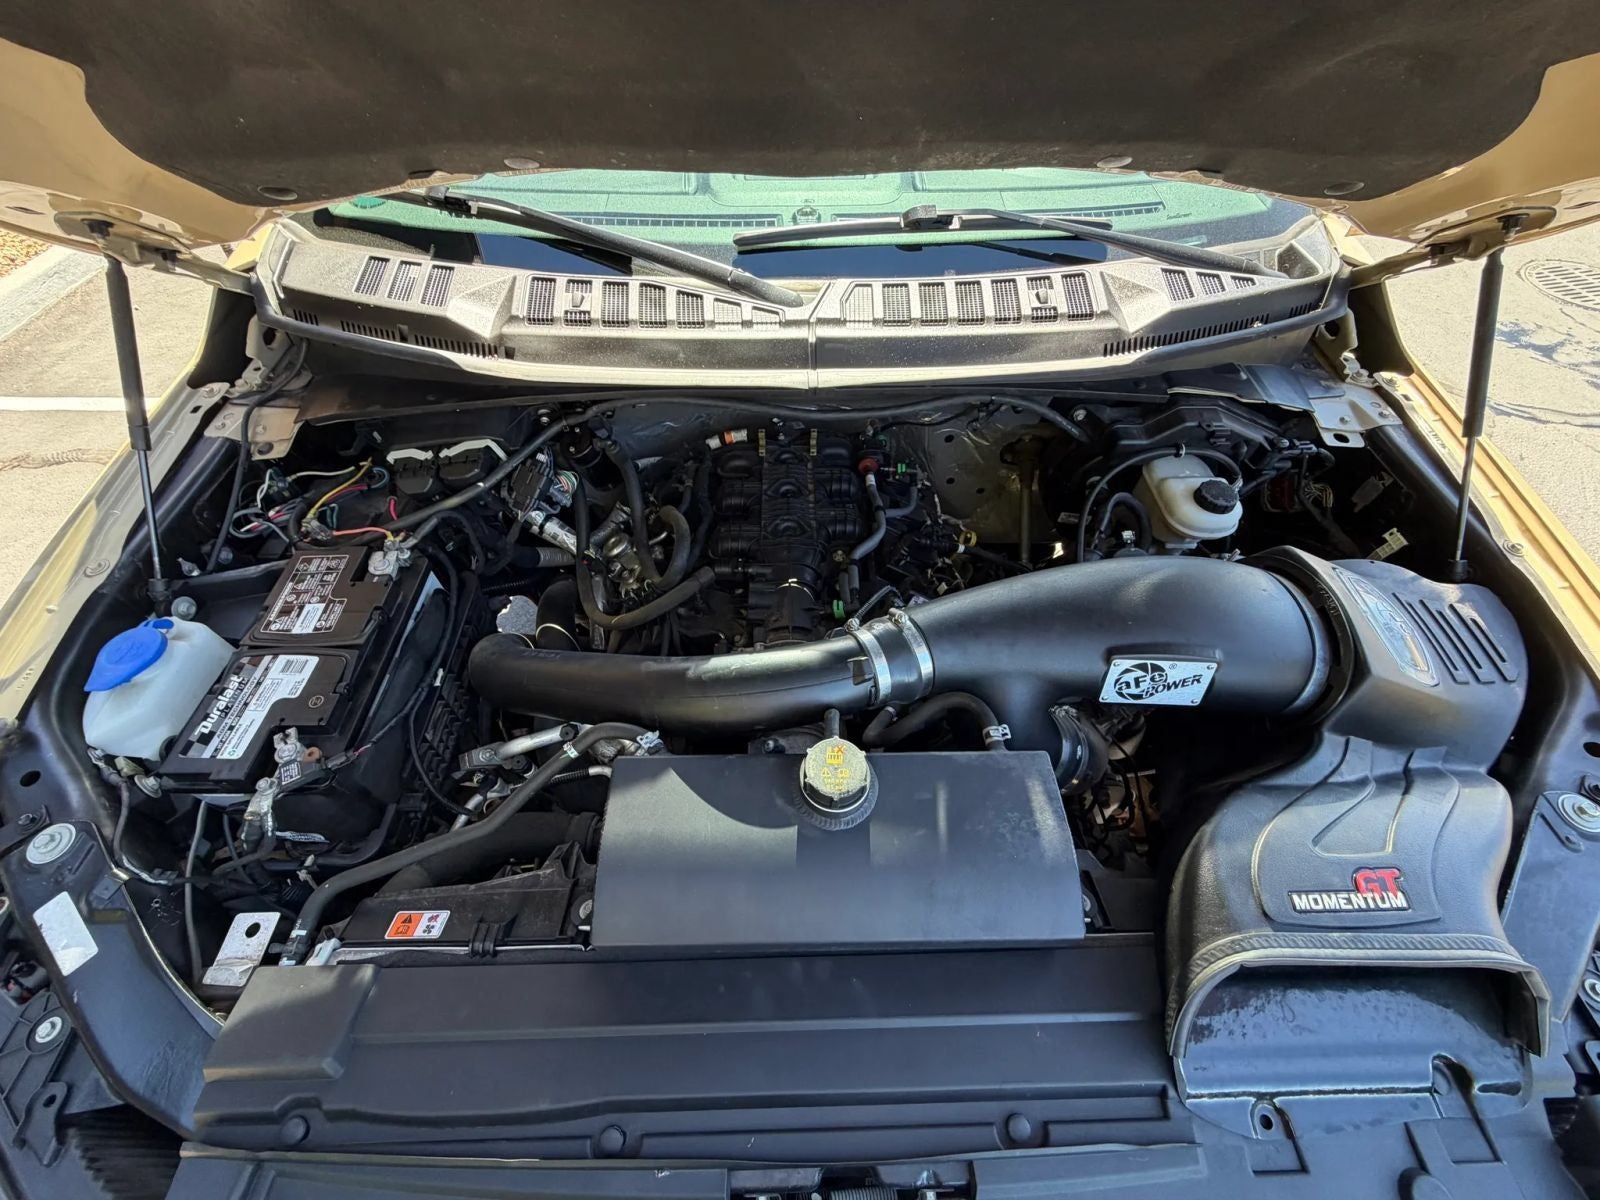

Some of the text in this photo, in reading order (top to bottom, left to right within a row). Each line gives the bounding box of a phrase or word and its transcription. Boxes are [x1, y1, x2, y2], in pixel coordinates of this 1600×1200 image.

[1117, 673, 1166, 692] aFe
[1143, 674, 1203, 698] POWER
[194, 674, 243, 735] Duralast
[217, 722, 229, 739] AGM
[229, 677, 257, 721] TECHNOLOGY
[220, 677, 248, 719] PLATINUM
[1355, 867, 1401, 896] GT
[1291, 890, 1408, 910] MOMENTUM
